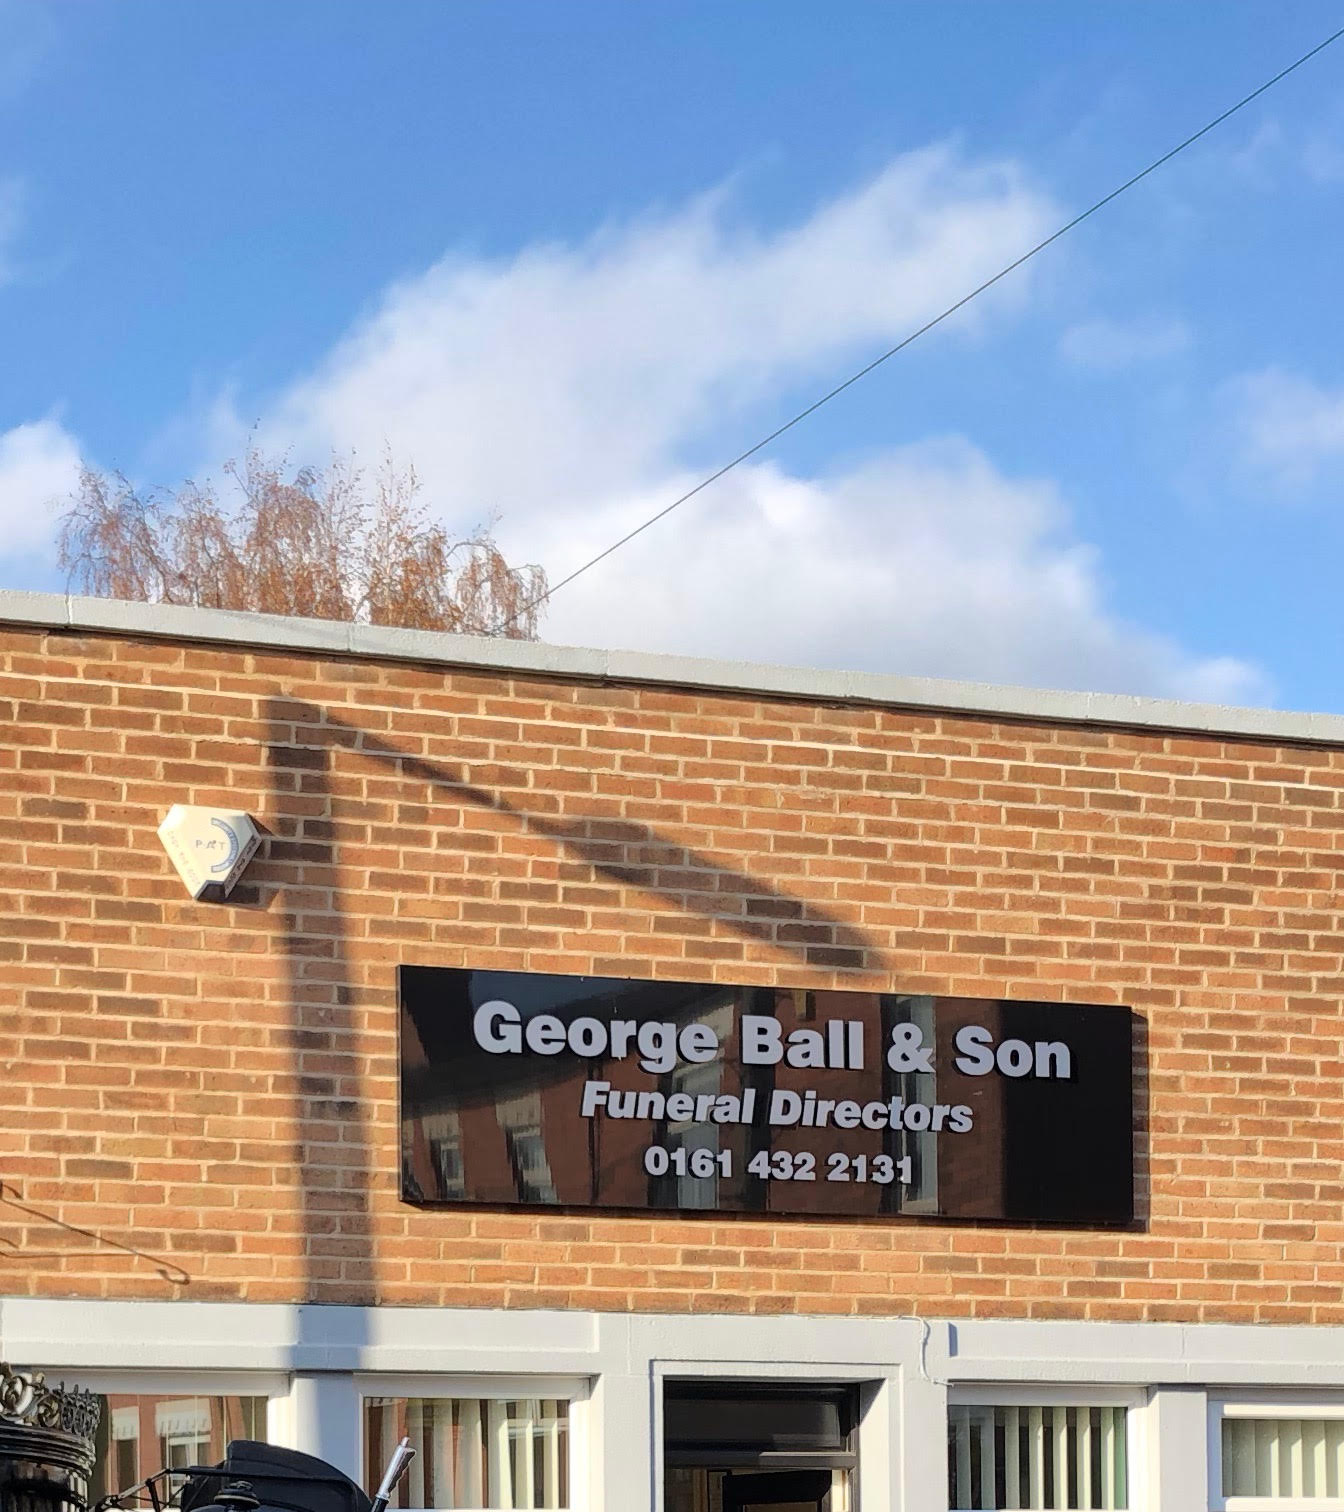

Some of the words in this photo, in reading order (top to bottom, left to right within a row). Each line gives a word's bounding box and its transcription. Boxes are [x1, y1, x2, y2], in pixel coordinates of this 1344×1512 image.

[473, 1000, 719, 1074] George
[741, 1014, 864, 1070] Ball
[887, 1022, 936, 1073] &
[955, 1025, 1071, 1079] Son
[581, 1080, 756, 1124] Funeral
[769, 1089, 974, 1133] Directors
[644, 1145, 733, 1178] 0161
[747, 1150, 816, 1180] 432
[827, 1152, 912, 1184] 2131
